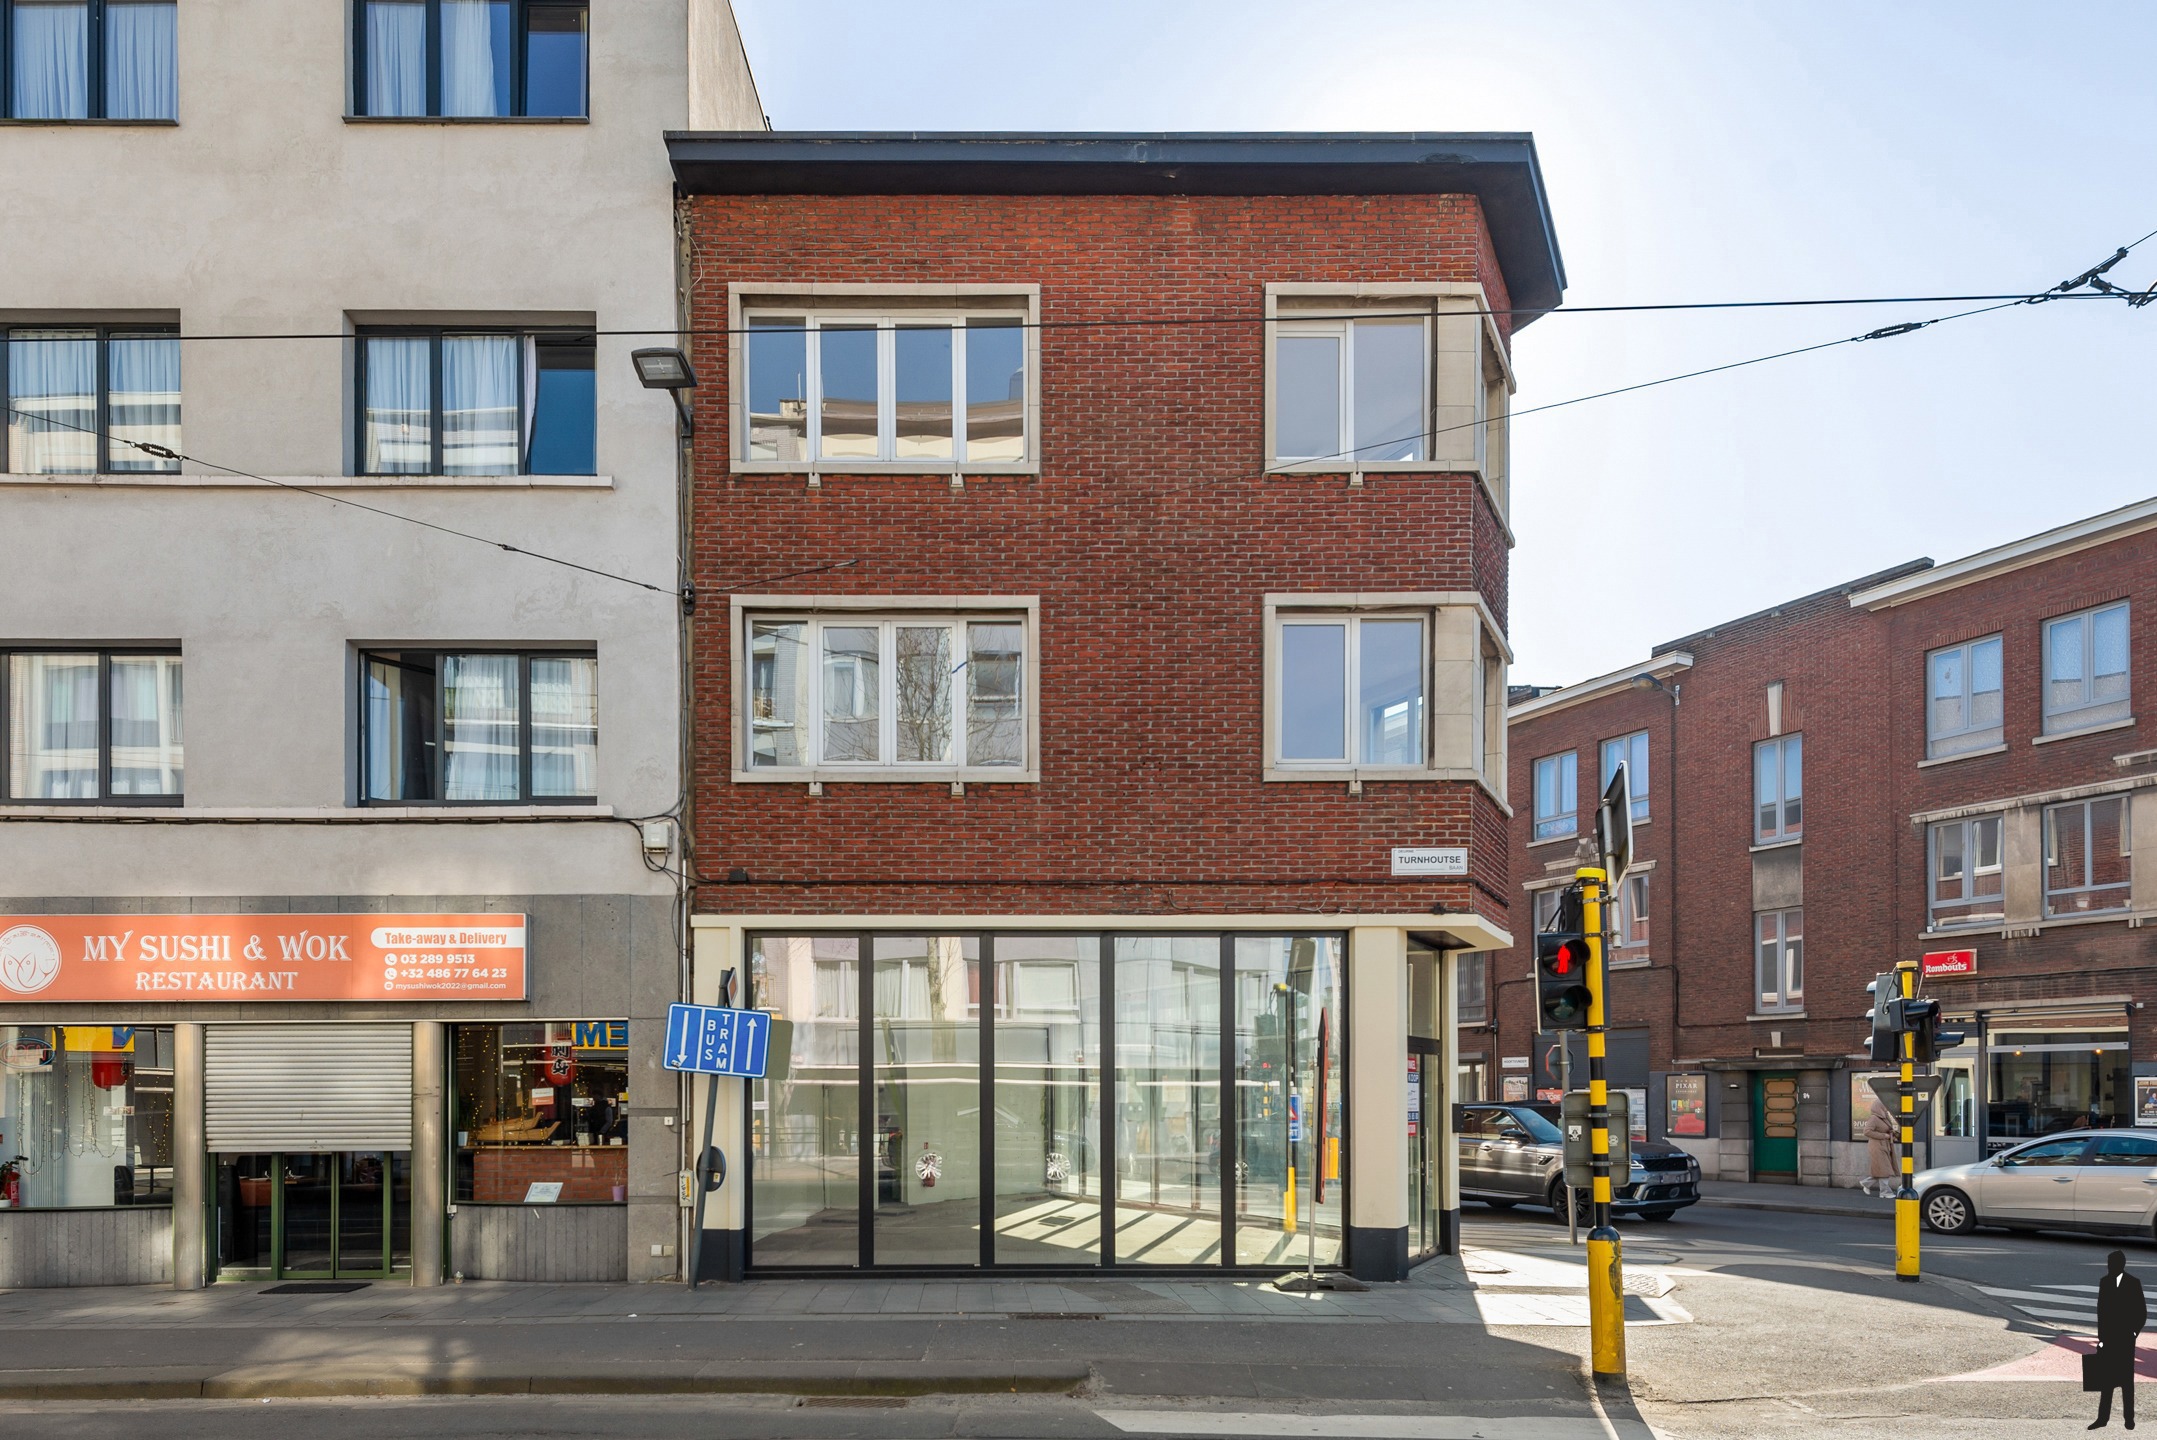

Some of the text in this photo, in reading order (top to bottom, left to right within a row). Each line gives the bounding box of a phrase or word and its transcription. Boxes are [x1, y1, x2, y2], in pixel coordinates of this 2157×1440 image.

[1398, 856, 1461, 864] TURNHOUTSE
[385, 932, 507, 945] Take-away & Delivery
[82, 929, 134, 962] MY
[139, 935, 232, 962] SUSHI
[243, 934, 267, 962] &
[278, 929, 352, 962] WOK
[400, 954, 475, 964] 03 289 9513
[400, 968, 507, 978] +32 486 77 64 23
[1925, 962, 1968, 973] Rombouts
[135, 972, 298, 991] RESTAURANT
[395, 982, 506, 991] mysushiwok2022@gmail.com
[704, 1019, 717, 1061] BUS
[715, 1013, 731, 1069] TRAM
[2, 1043, 47, 1063] OPEN
